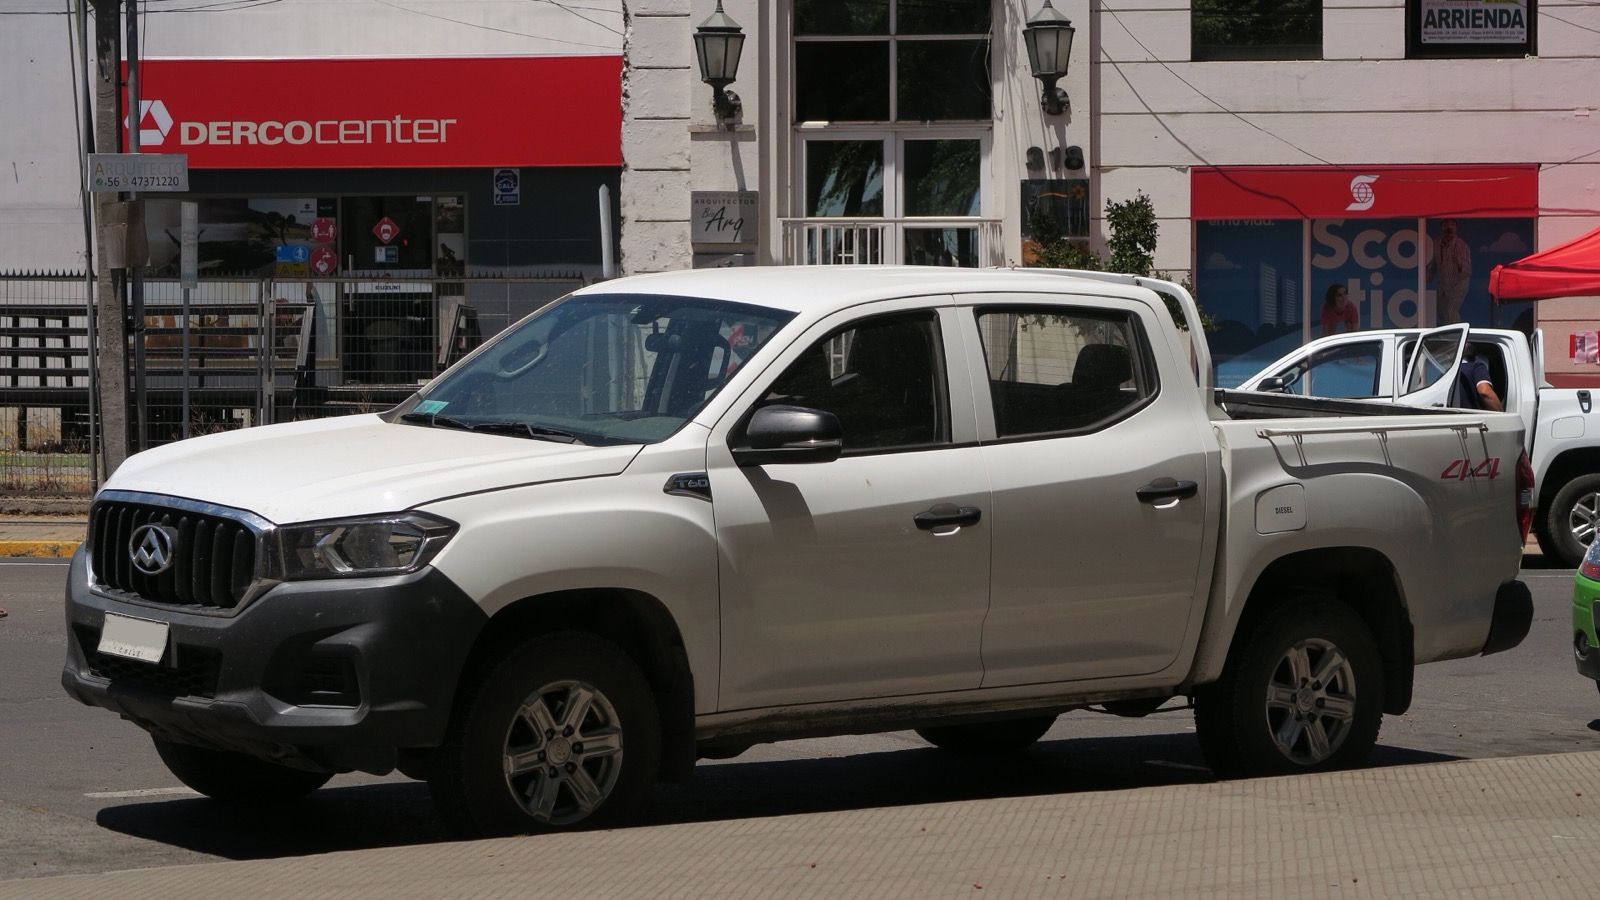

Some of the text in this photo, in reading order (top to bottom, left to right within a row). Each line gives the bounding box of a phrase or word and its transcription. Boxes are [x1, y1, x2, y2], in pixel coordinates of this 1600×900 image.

[1423, 8, 1525, 29] ARRIENDA
[95, 161, 185, 175] ARQUITECTO
[131, 176, 180, 187] 47371220
[704, 205, 744, 242] Arq
[1312, 218, 1434, 270] Sco
[1347, 272, 1438, 329] tia
[1440, 457, 1501, 481] 4x4
[675, 479, 709, 488] T60
[1275, 506, 1294, 515] DIESEL
